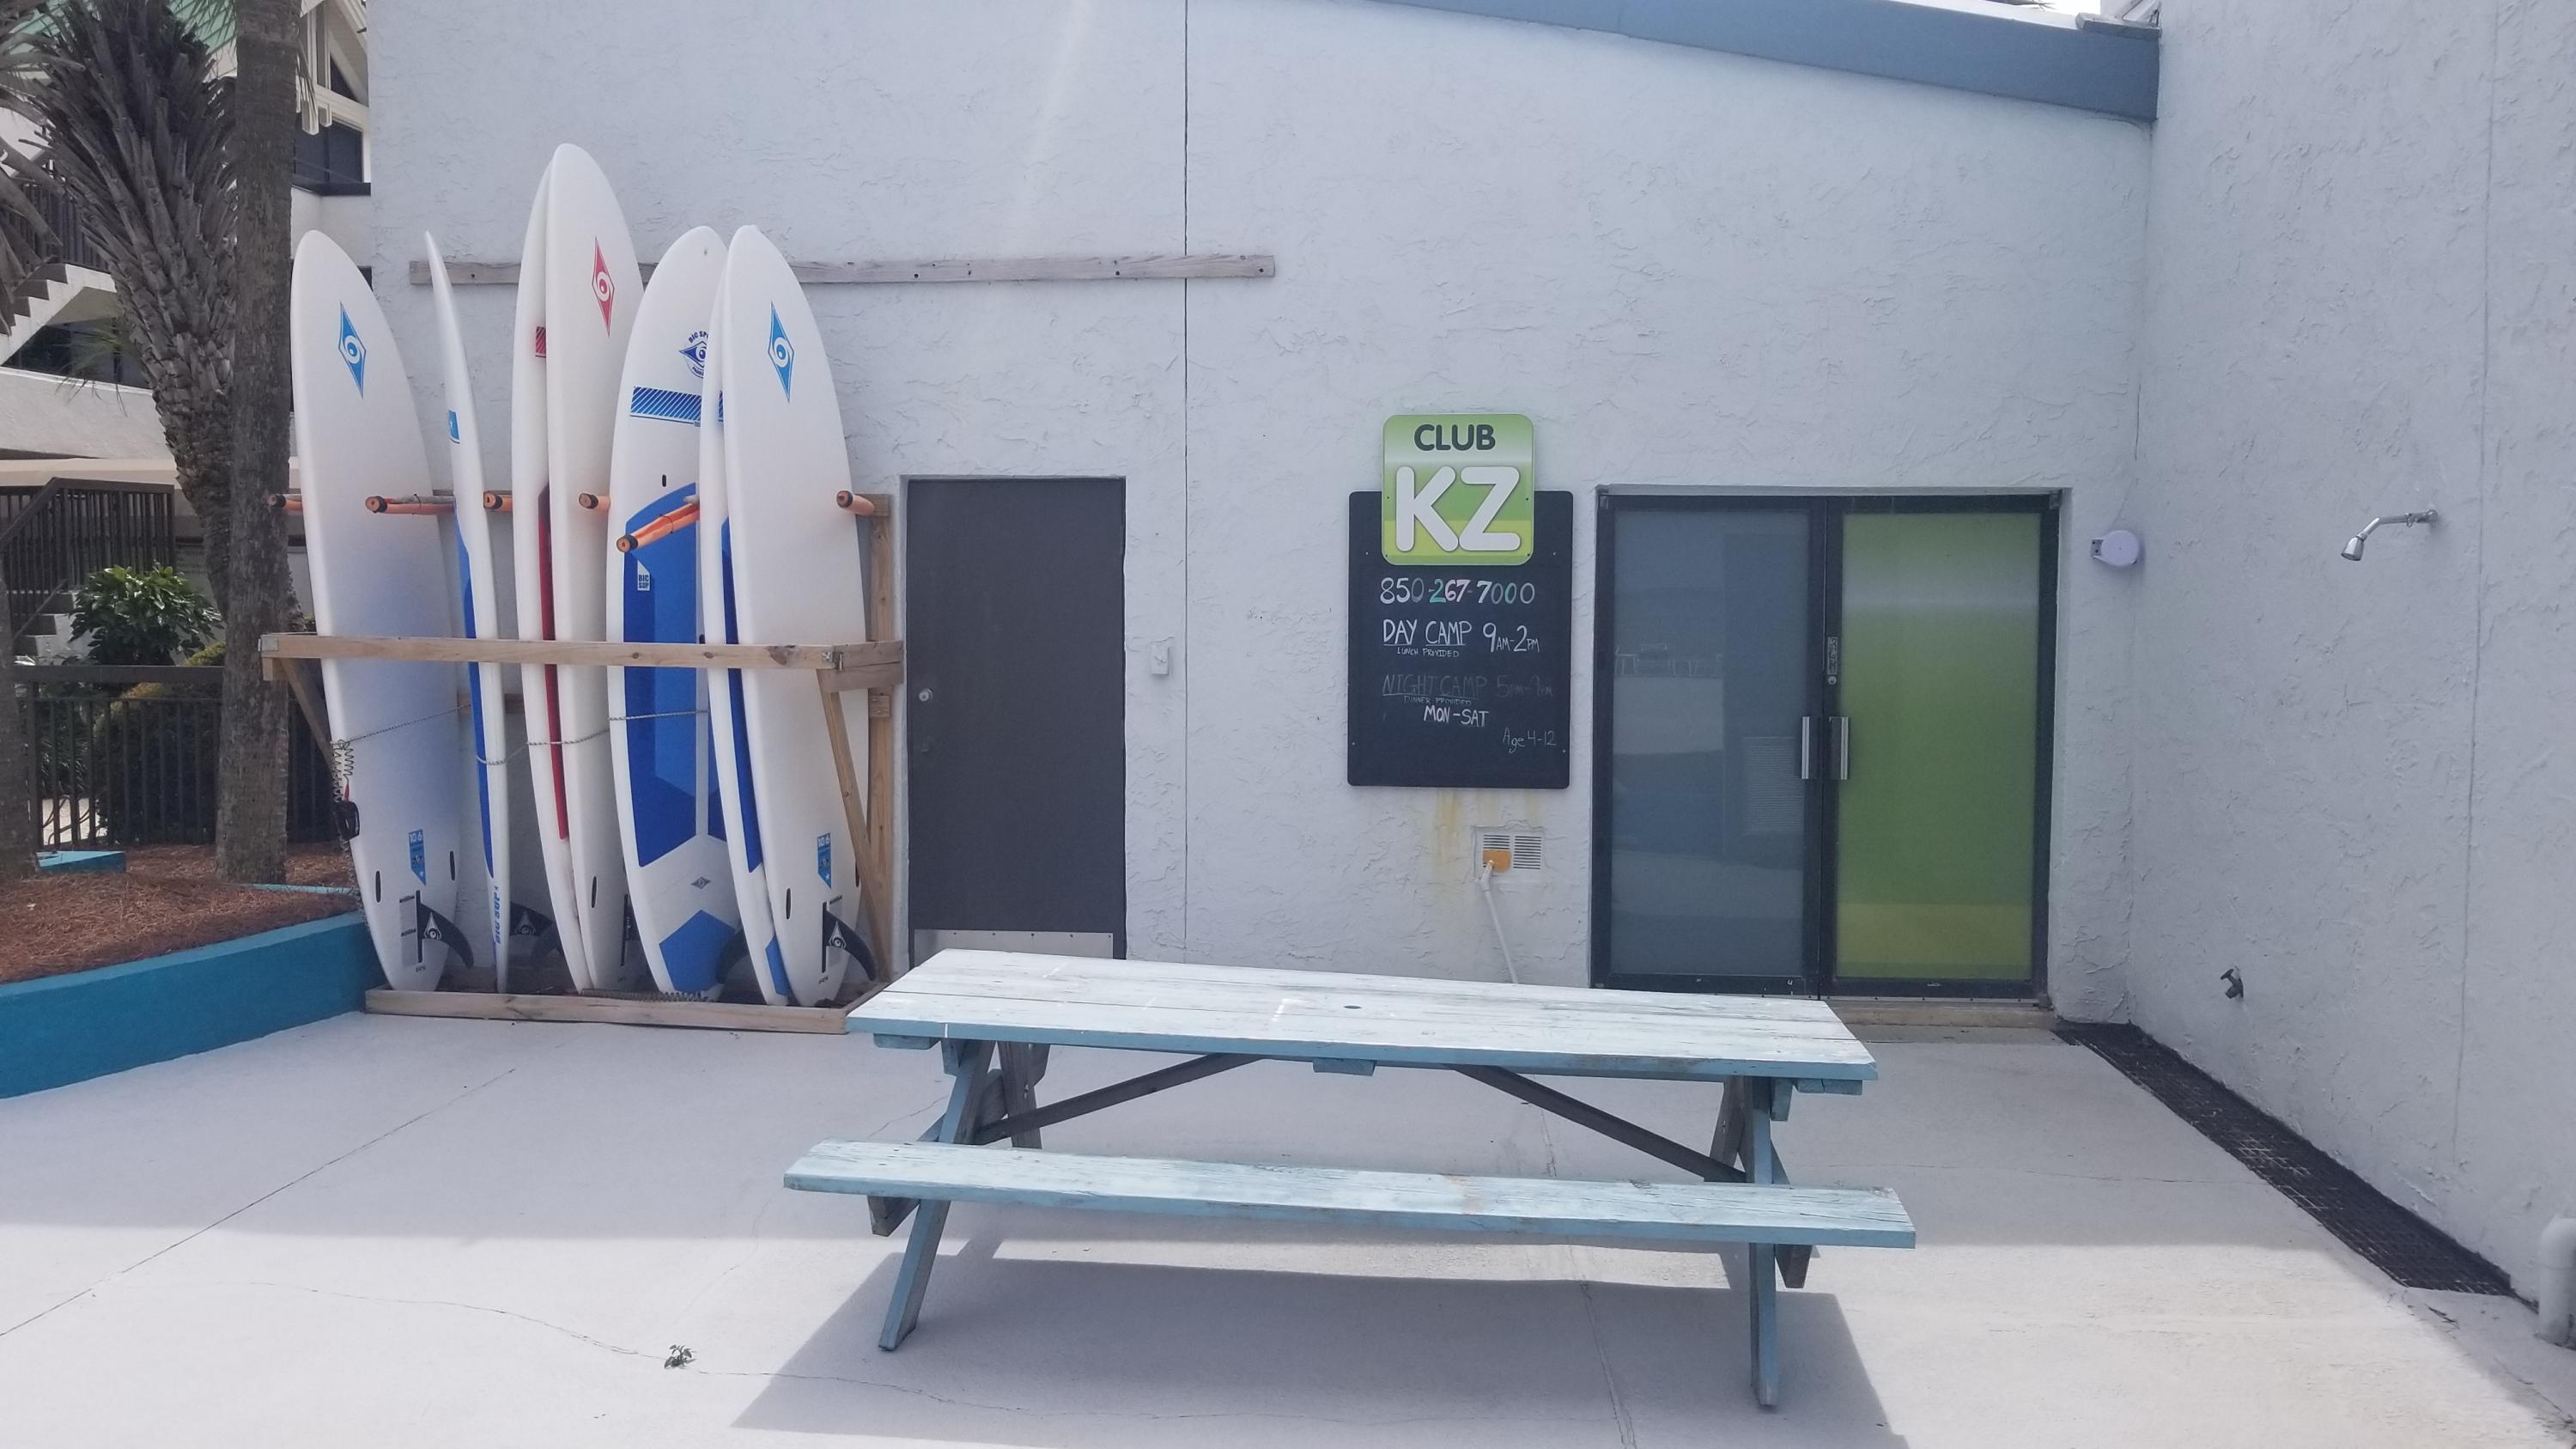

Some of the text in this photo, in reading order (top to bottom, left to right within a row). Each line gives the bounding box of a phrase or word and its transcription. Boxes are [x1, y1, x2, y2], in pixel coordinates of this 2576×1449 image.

[1414, 423, 1496, 451] CLUB
[1395, 466, 1522, 552] KZ
[1382, 619, 1417, 644] DAY
[1425, 620, 1472, 645] CAMP
[1423, 648, 1460, 658] PROVIDED
[1382, 673, 1440, 696] NIGHT
[1440, 675, 1487, 698] CAMP
[1404, 695, 1472, 706] DINNER PROVIDED
[1503, 728, 1557, 753] Age 4-12
